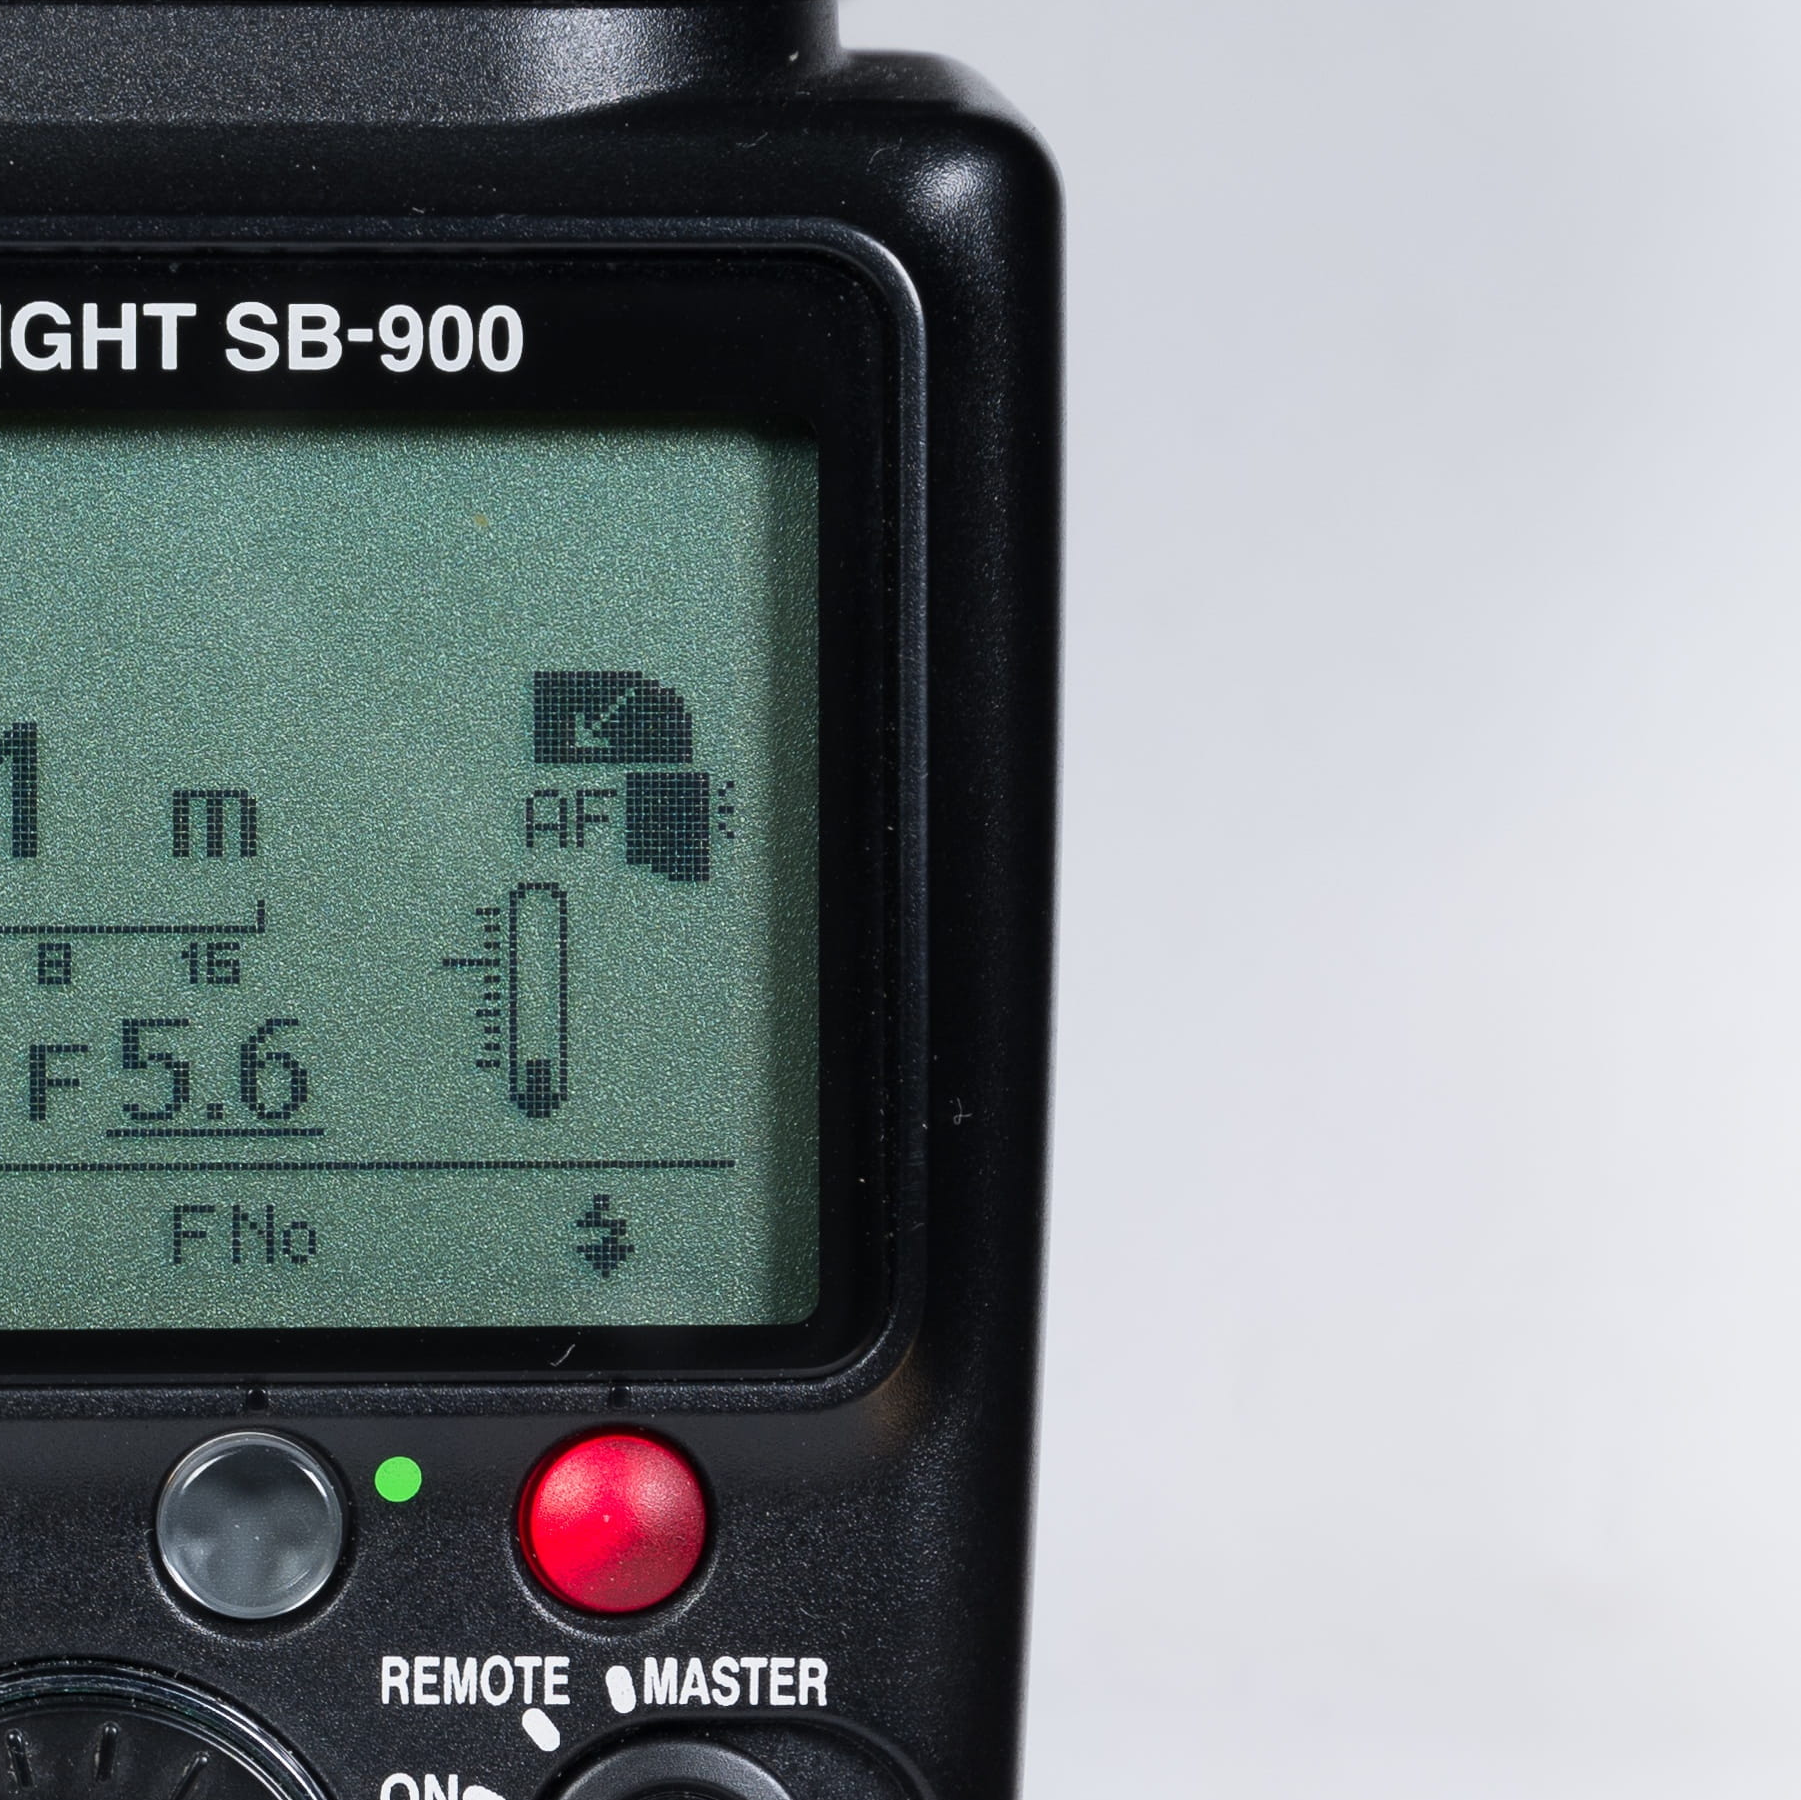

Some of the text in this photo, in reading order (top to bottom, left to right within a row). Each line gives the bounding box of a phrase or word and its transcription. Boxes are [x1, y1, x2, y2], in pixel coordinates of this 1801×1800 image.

[223, 301, 525, 374] SB-900
[172, 789, 258, 859] m
[525, 789, 618, 849] AF
[37, 942, 72, 985] 8
[180, 941, 241, 985] 16
[29, 1043, 90, 1122] F
[122, 1018, 309, 1121] 5.6
[381, 1655, 571, 1707] REMOTE
[643, 1656, 829, 1707] MASTER
